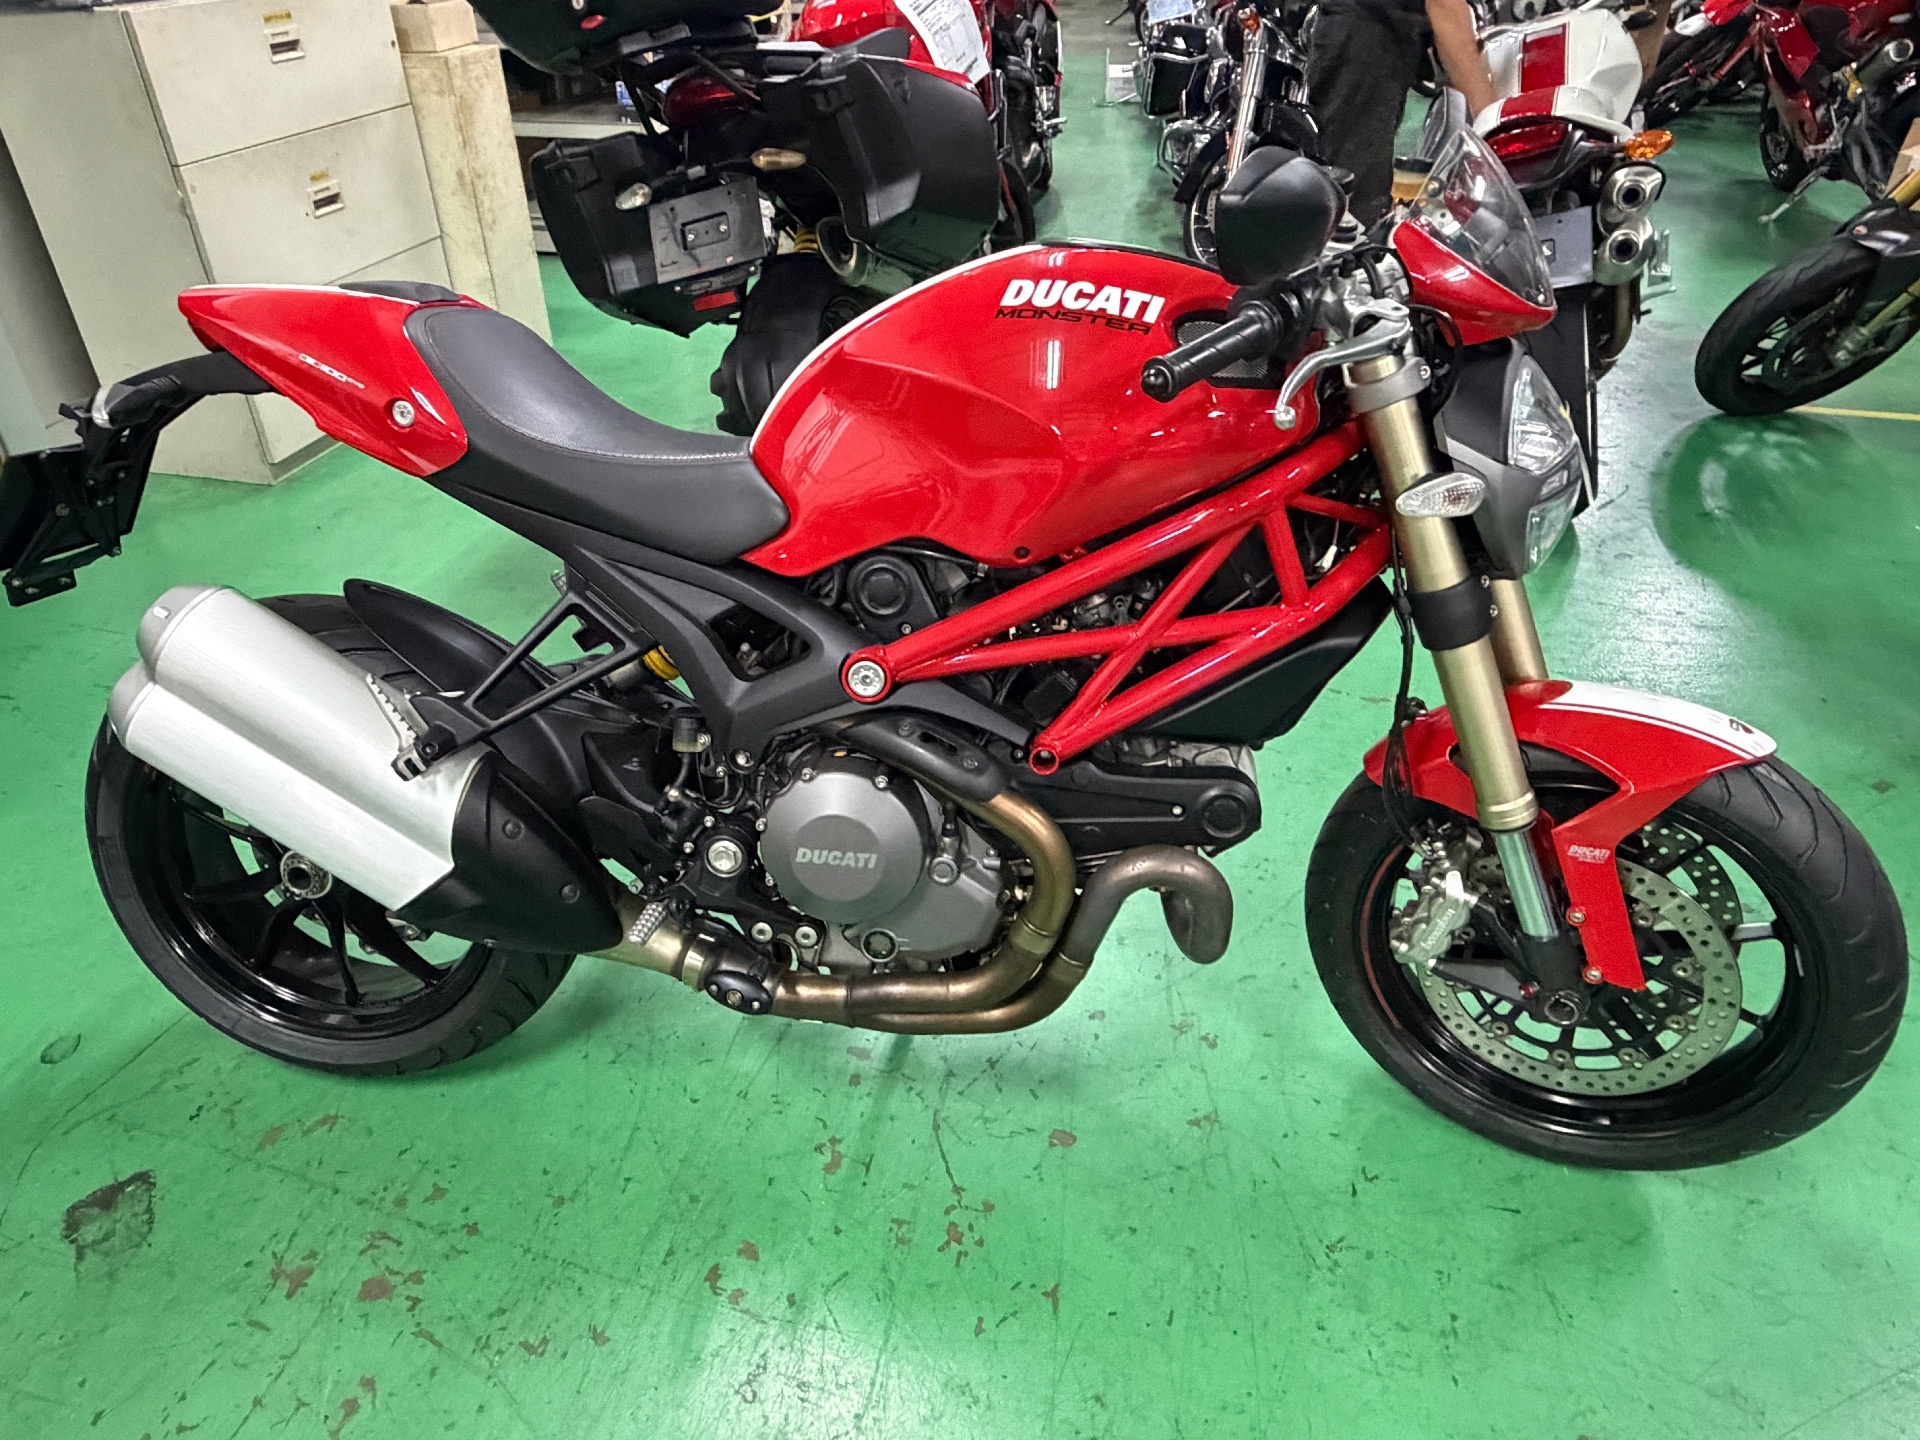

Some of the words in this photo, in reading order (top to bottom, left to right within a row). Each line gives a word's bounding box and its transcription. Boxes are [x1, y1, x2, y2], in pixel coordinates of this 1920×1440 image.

[1000, 279, 1166, 324] DUCATI
[995, 308, 1152, 336] MONSTER
[795, 846, 878, 869] DUCATI
[1567, 845, 1611, 862] DUCATI
